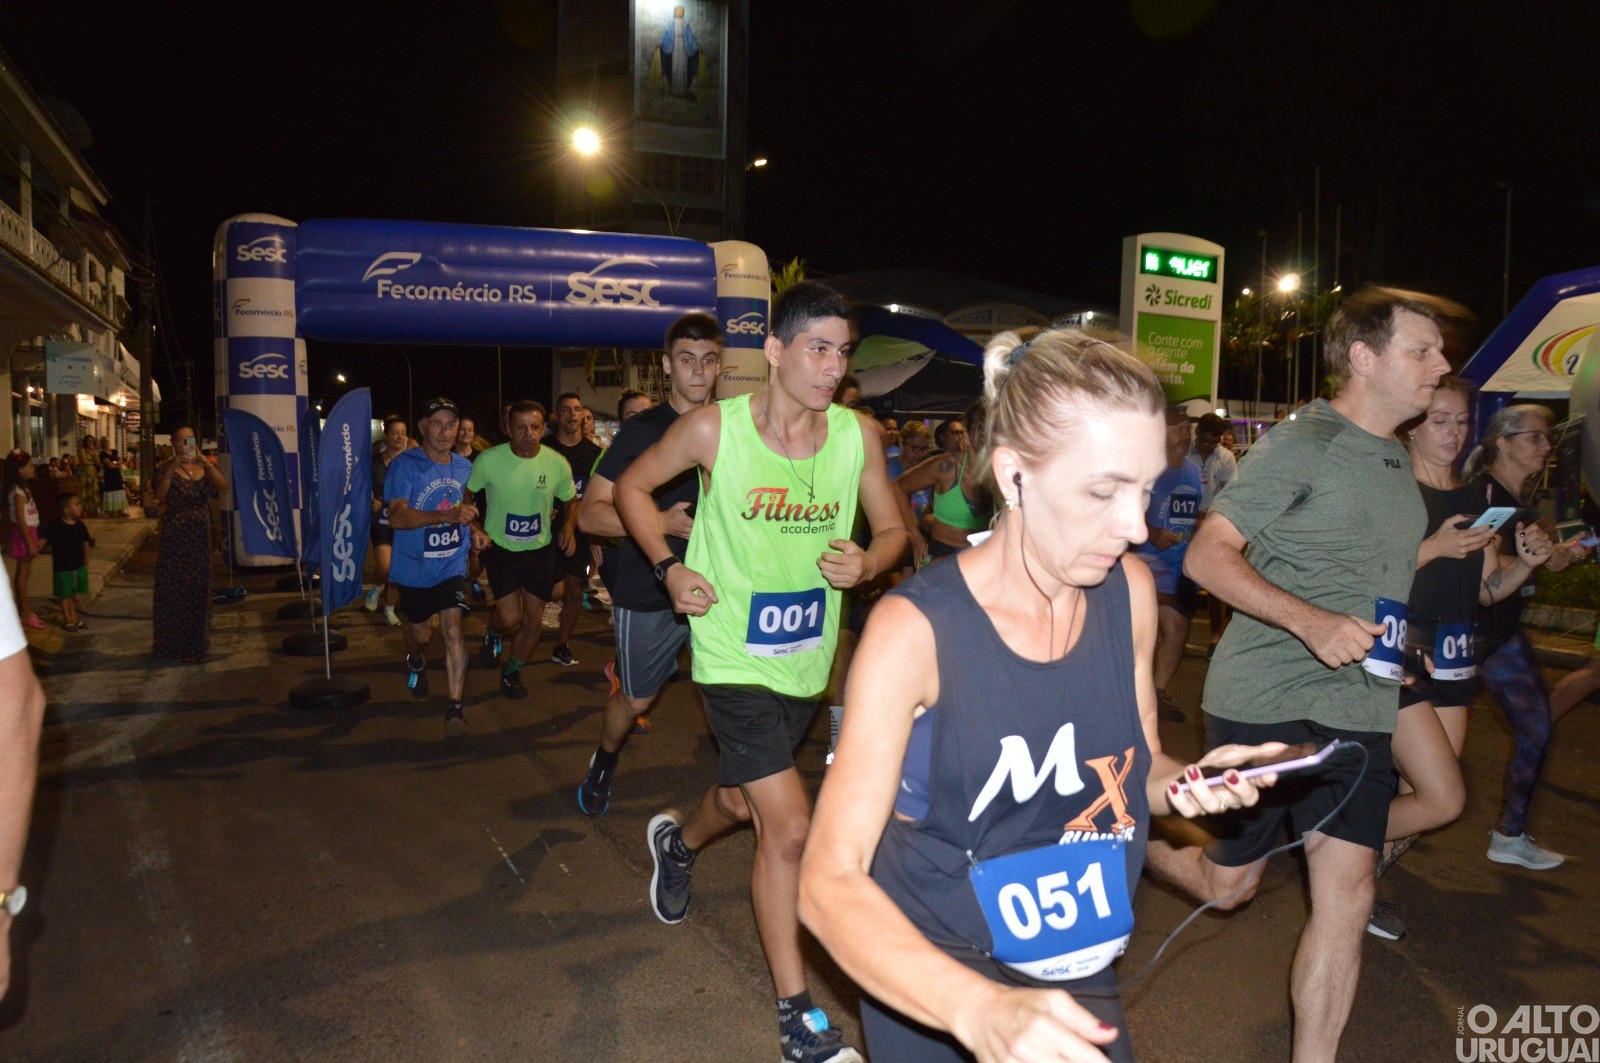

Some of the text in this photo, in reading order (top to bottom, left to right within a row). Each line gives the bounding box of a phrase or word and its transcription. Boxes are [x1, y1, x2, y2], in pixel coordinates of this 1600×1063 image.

[376, 279, 537, 303] Fecomércio RS
[565, 271, 660, 307] Sesc
[1164, 289, 1213, 310] Sicredi
[1148, 331, 1204, 350] Conte com
[1157, 346, 1188, 359] gente
[1179, 361, 1196, 374] da
[740, 486, 840, 523] Fitness
[1172, 499, 1196, 514] 017
[509, 518, 539, 534] 024
[780, 520, 835, 535] academia
[428, 529, 460, 547] 084
[758, 601, 819, 634] 001
[998, 861, 1112, 941] 051
